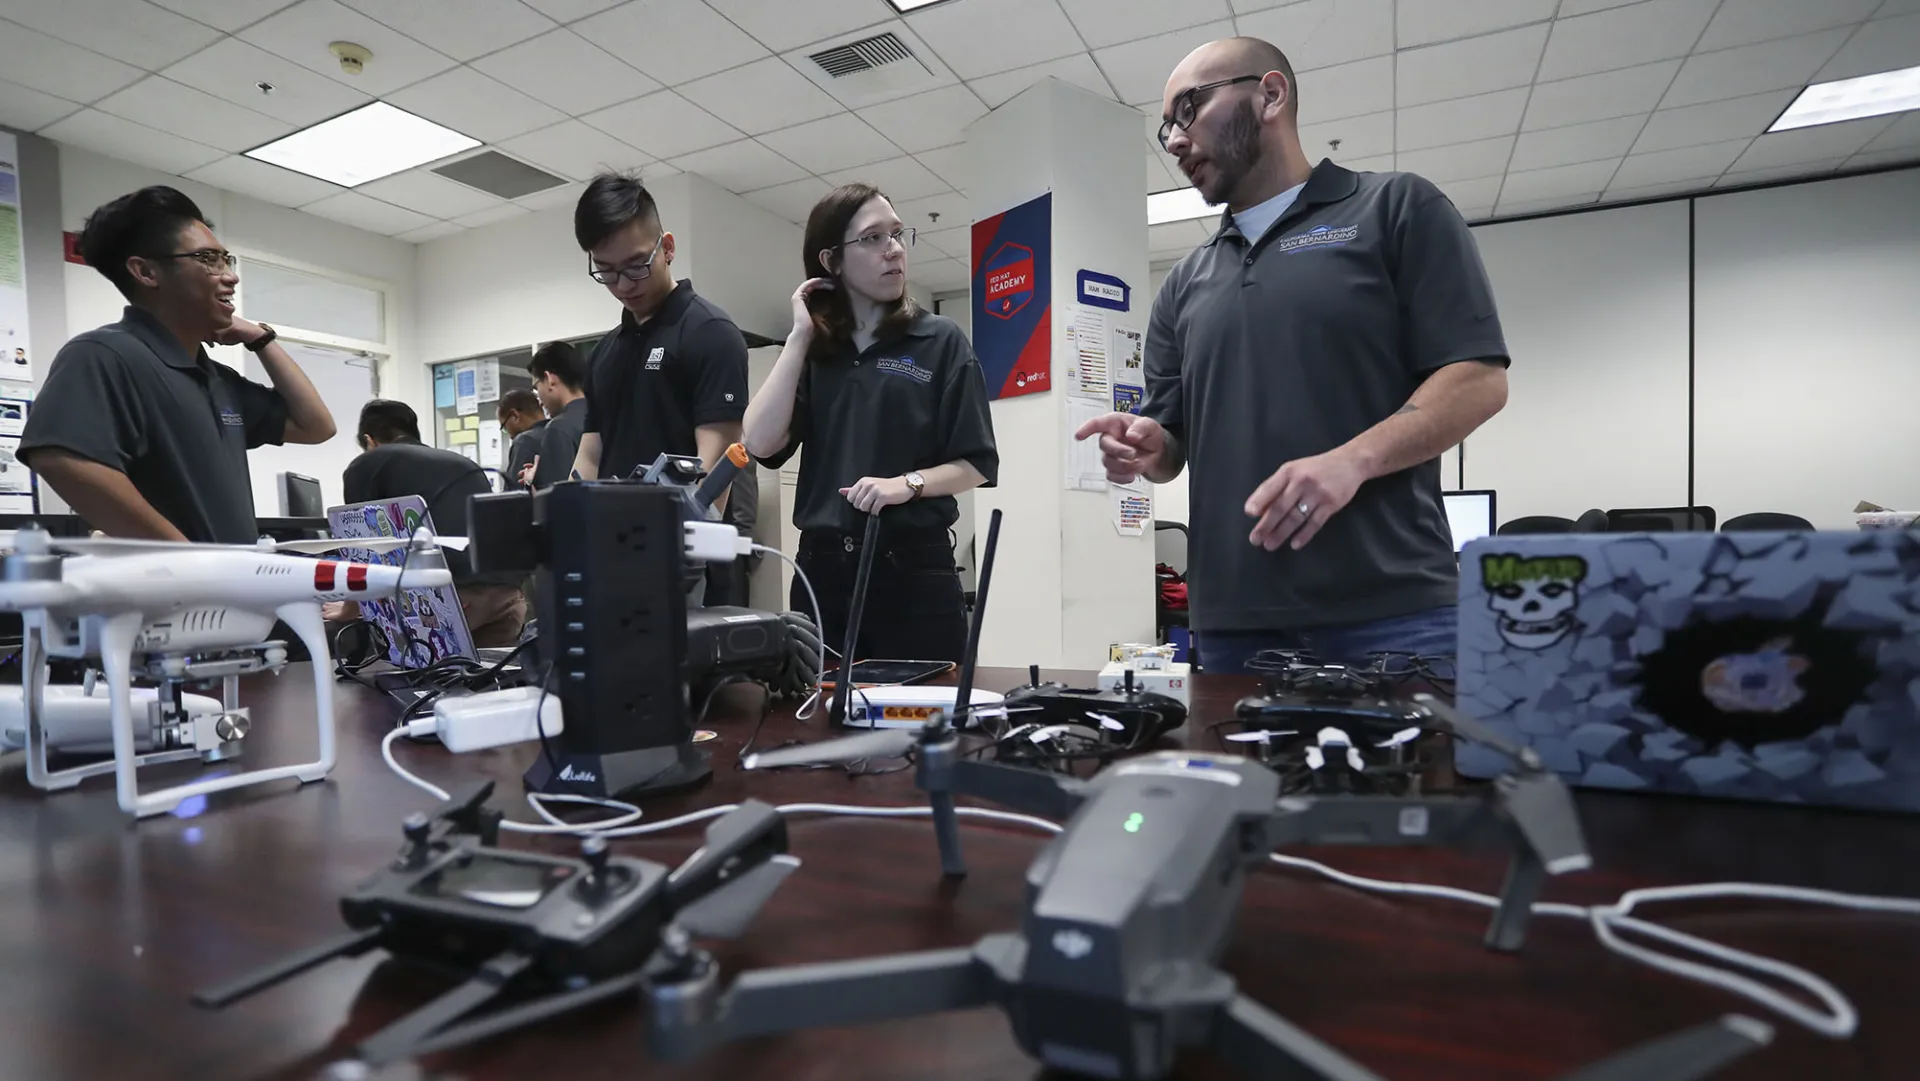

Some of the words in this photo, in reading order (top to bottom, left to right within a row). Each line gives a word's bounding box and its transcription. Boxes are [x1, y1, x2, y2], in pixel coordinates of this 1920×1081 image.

[1280, 240, 1298, 249] SAN
[1298, 230, 1357, 245] BERNARDINO
[990, 275, 1000, 284] RED
[1000, 271, 1010, 280] HAT
[990, 274, 1026, 294] ACADEMY
[1088, 285, 1100, 293] HAM
[1102, 287, 1121, 297] RADIO
